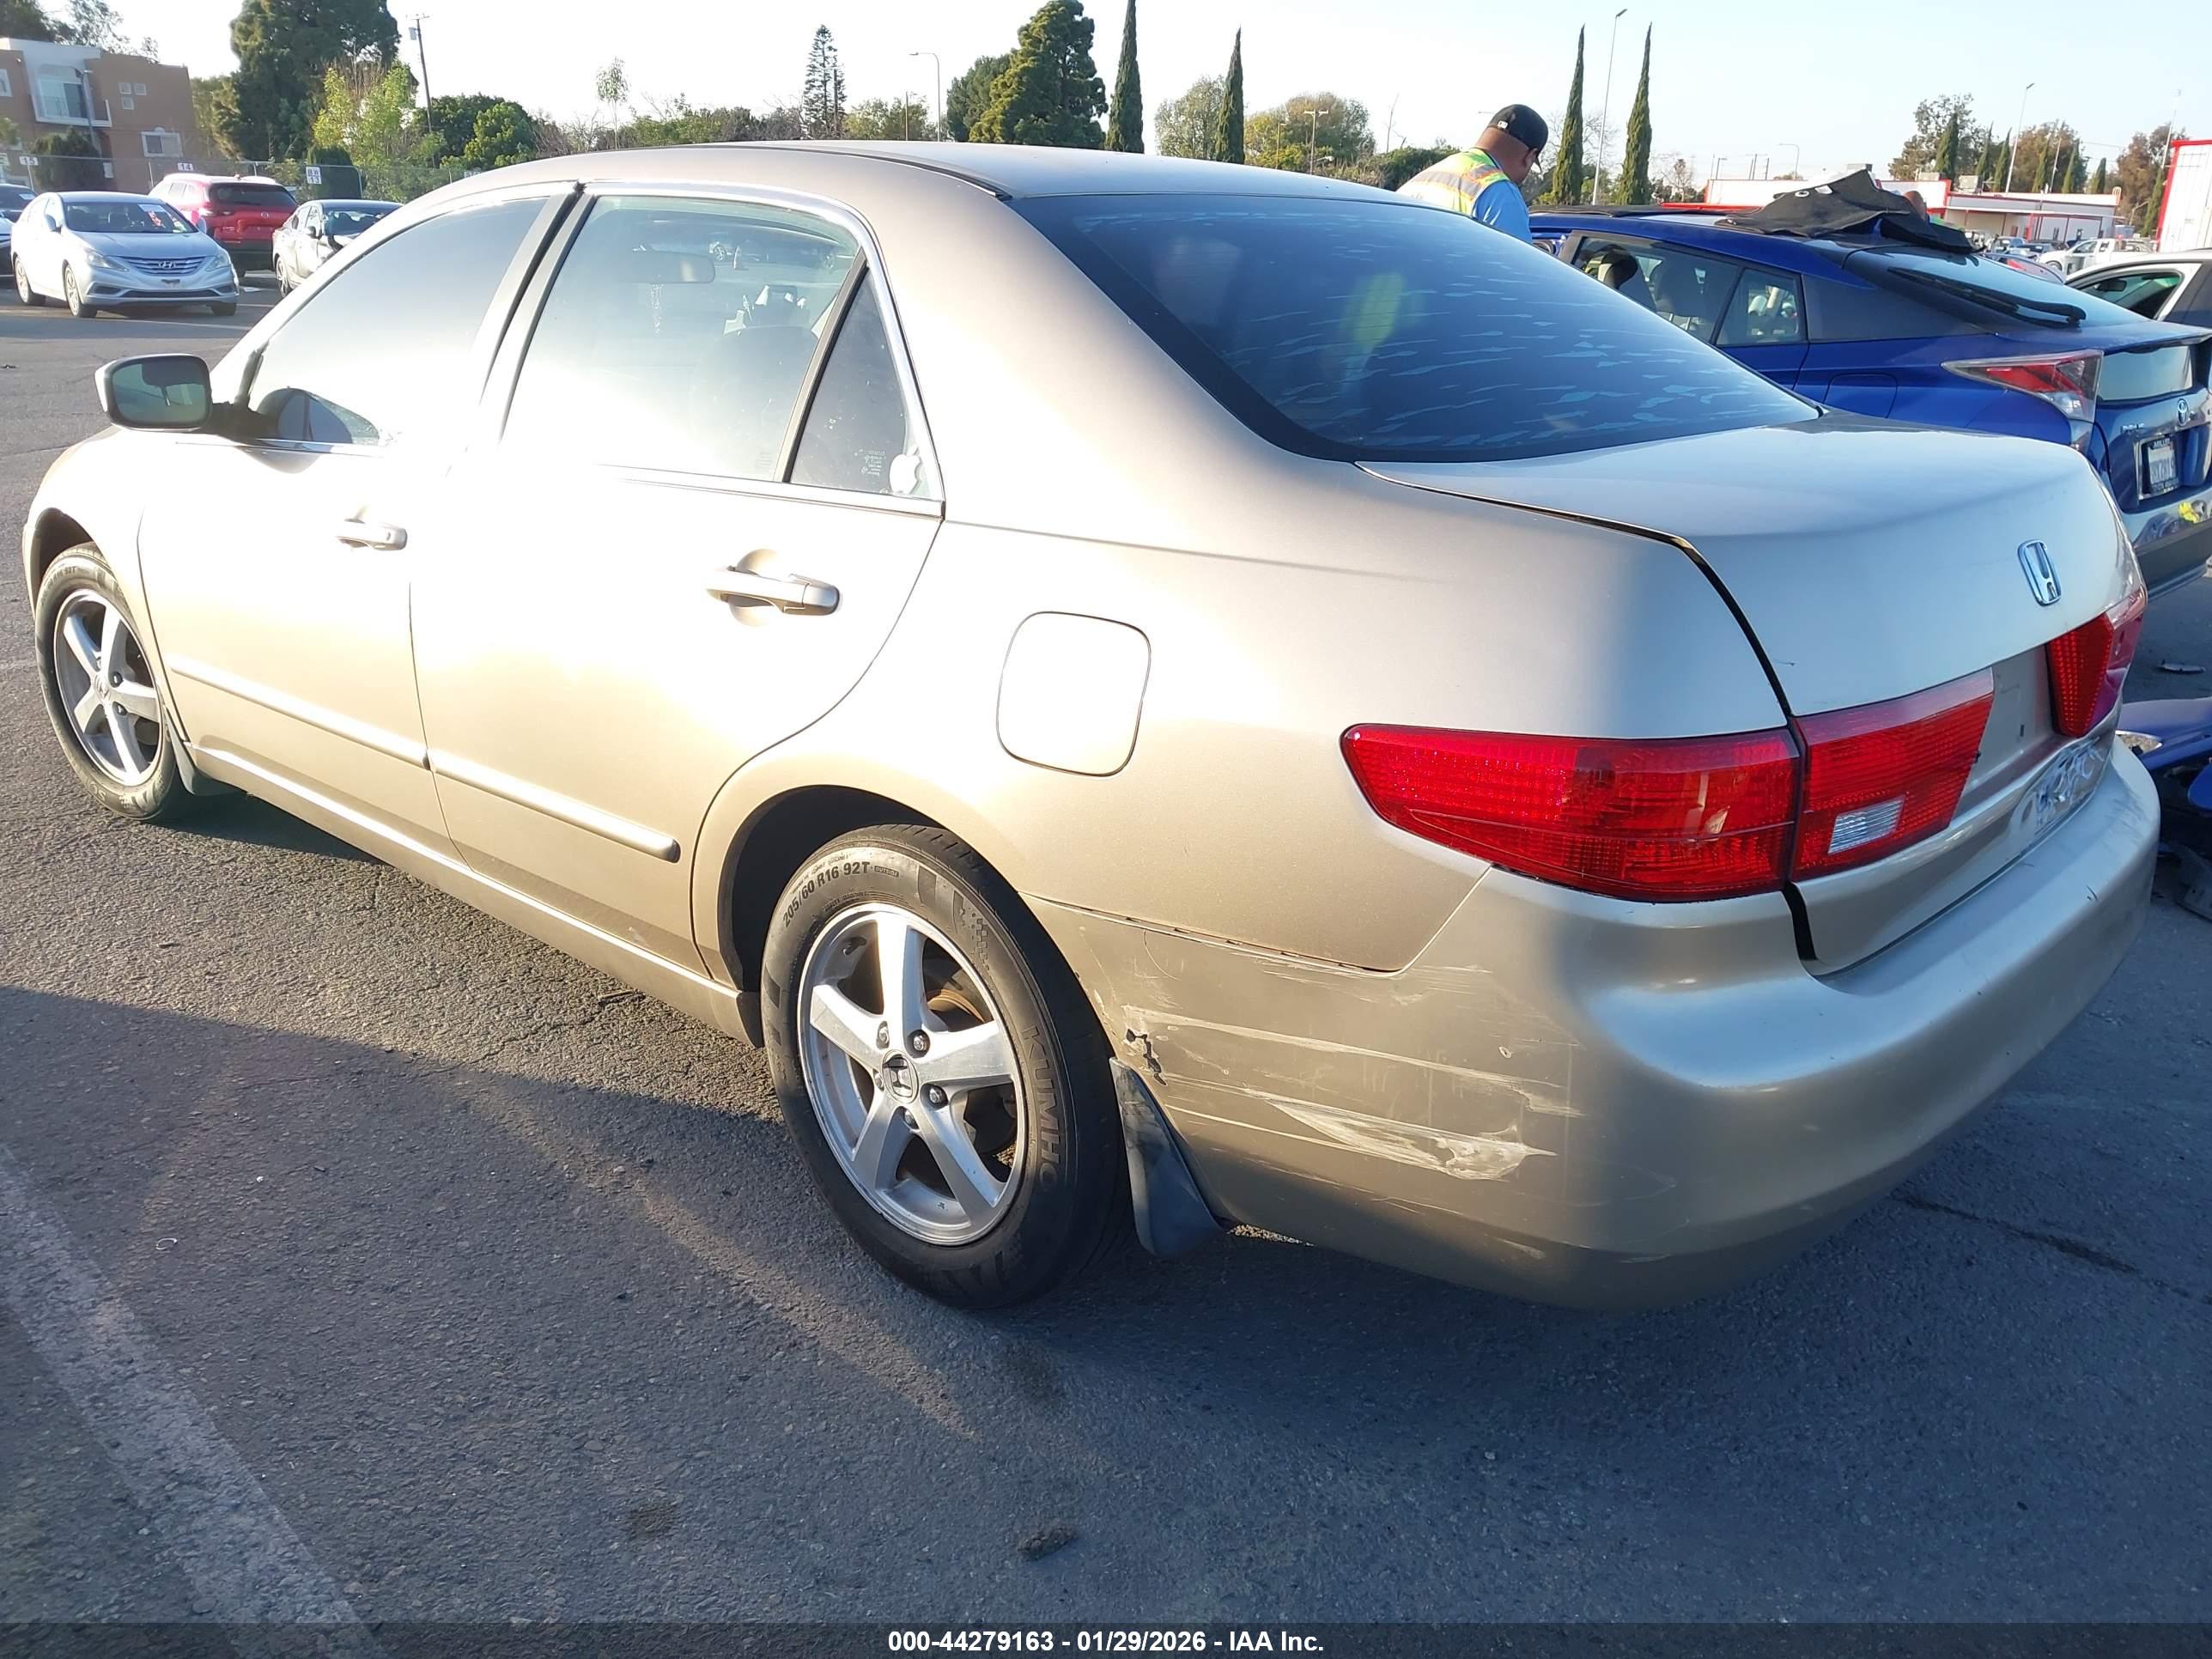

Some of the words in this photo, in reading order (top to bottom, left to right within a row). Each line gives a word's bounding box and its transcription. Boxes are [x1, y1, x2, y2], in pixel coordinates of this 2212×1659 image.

[783, 879, 815, 927] 205/60
[817, 866, 839, 888] R16
[843, 861, 870, 876] 92T
[874, 865, 899, 878] OUTSIDE
[1022, 1024, 1060, 1191] KUMHO
